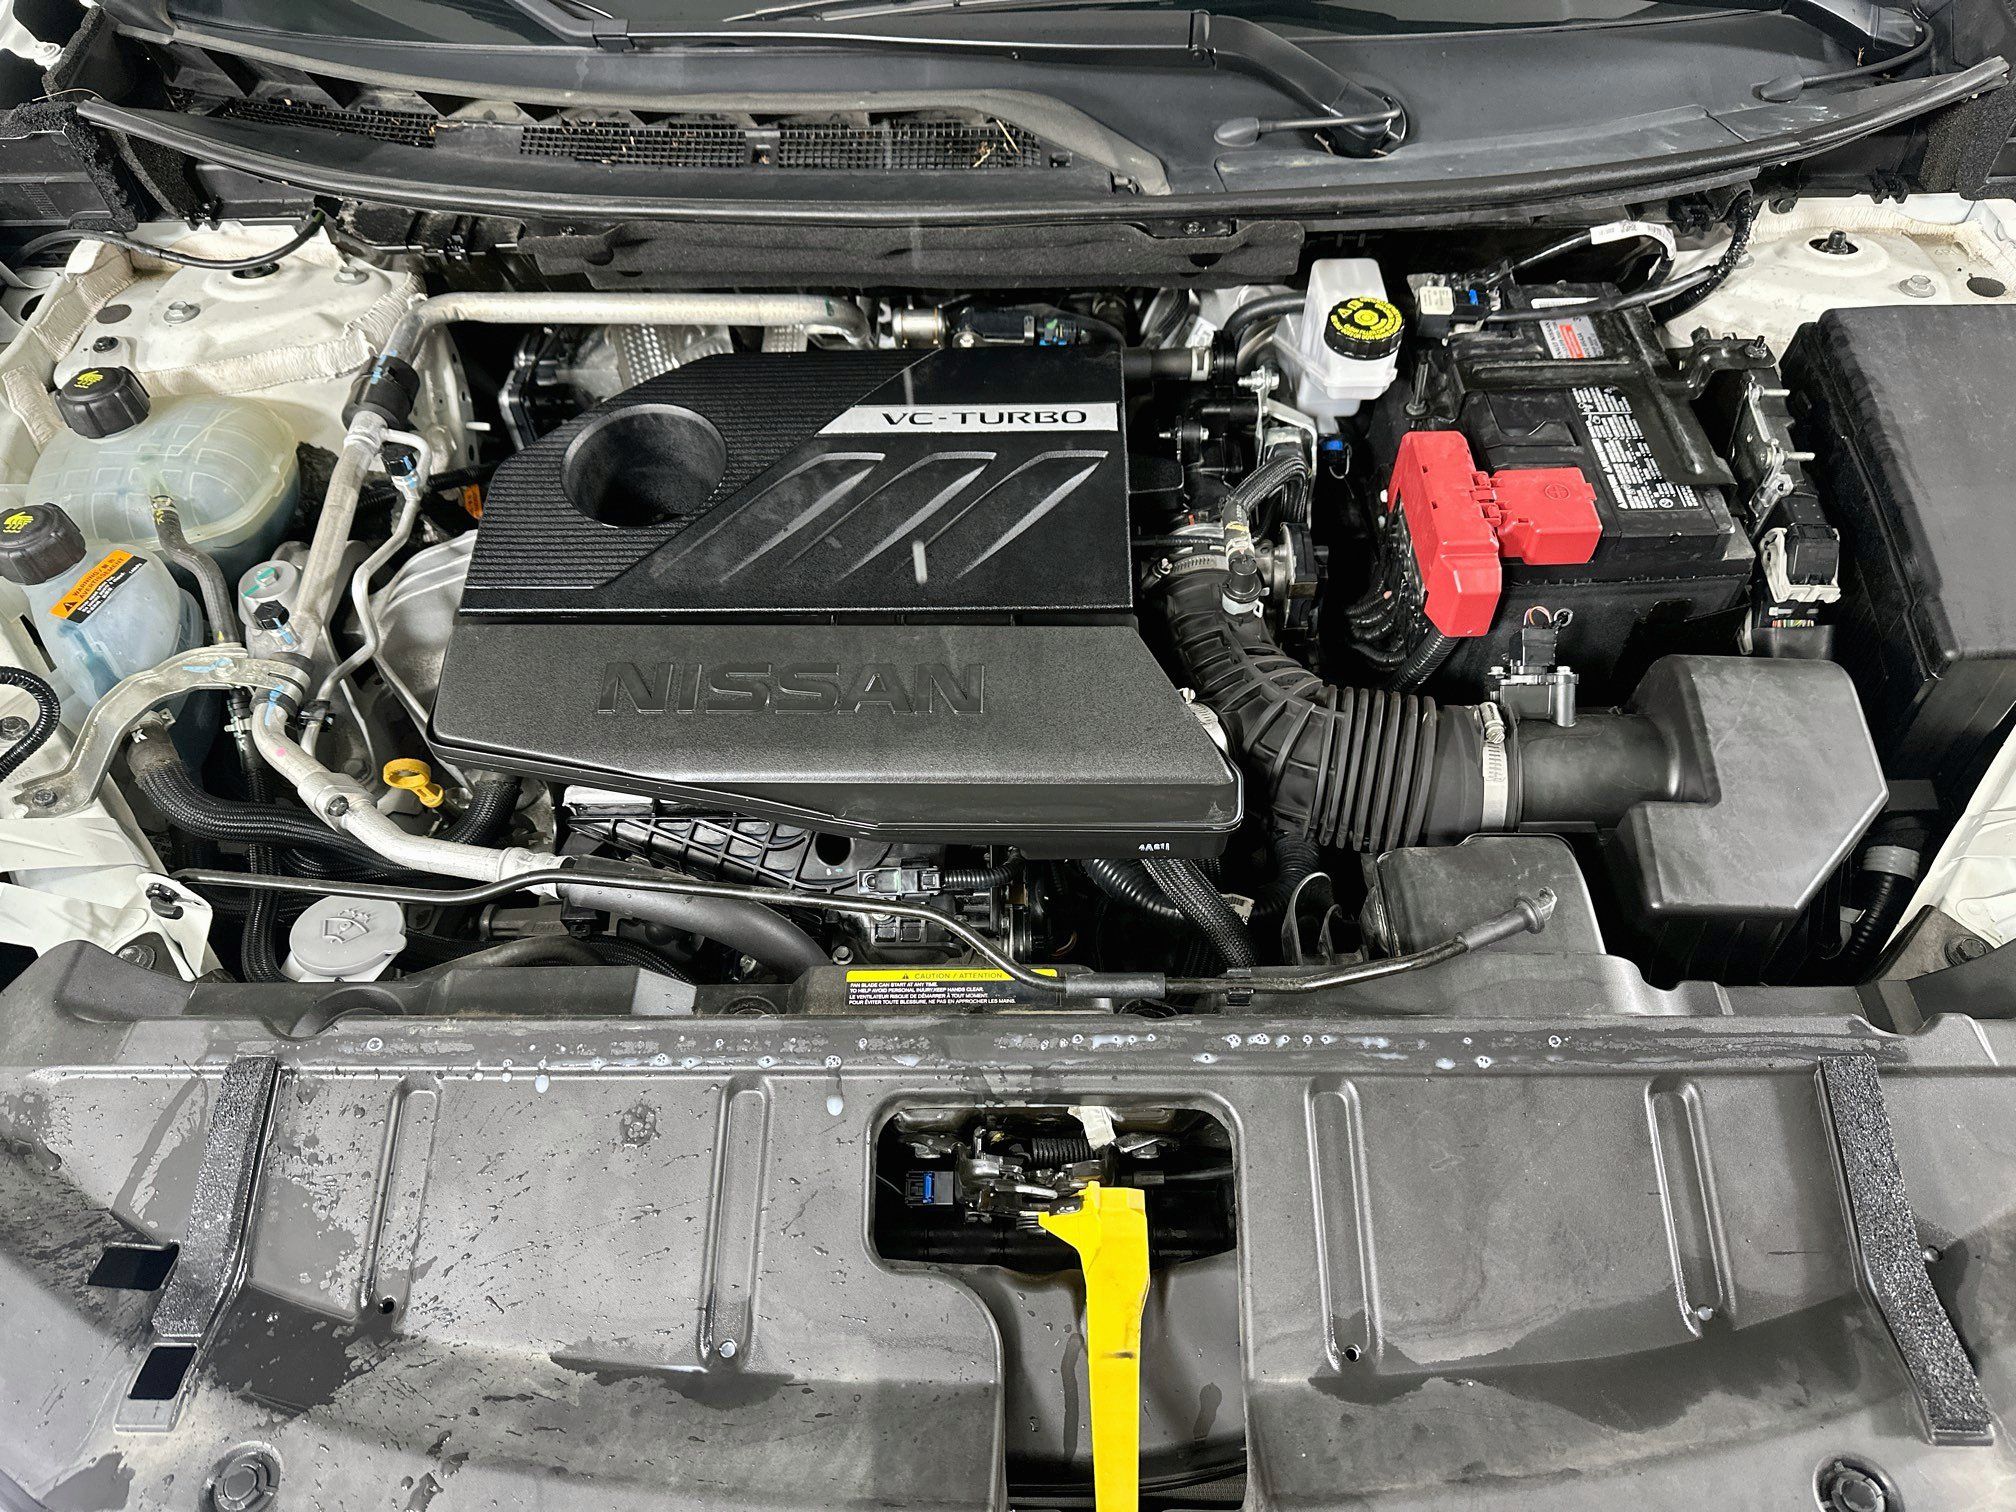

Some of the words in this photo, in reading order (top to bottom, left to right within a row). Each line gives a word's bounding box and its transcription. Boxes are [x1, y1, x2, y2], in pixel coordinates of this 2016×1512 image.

[882, 410, 1087, 425] VC-TURBO
[73, 569, 100, 597] WARNING
[80, 557, 124, 599] AVERTISSEMENT
[597, 661, 985, 715] NISSAN
[131, 728, 147, 743] K
